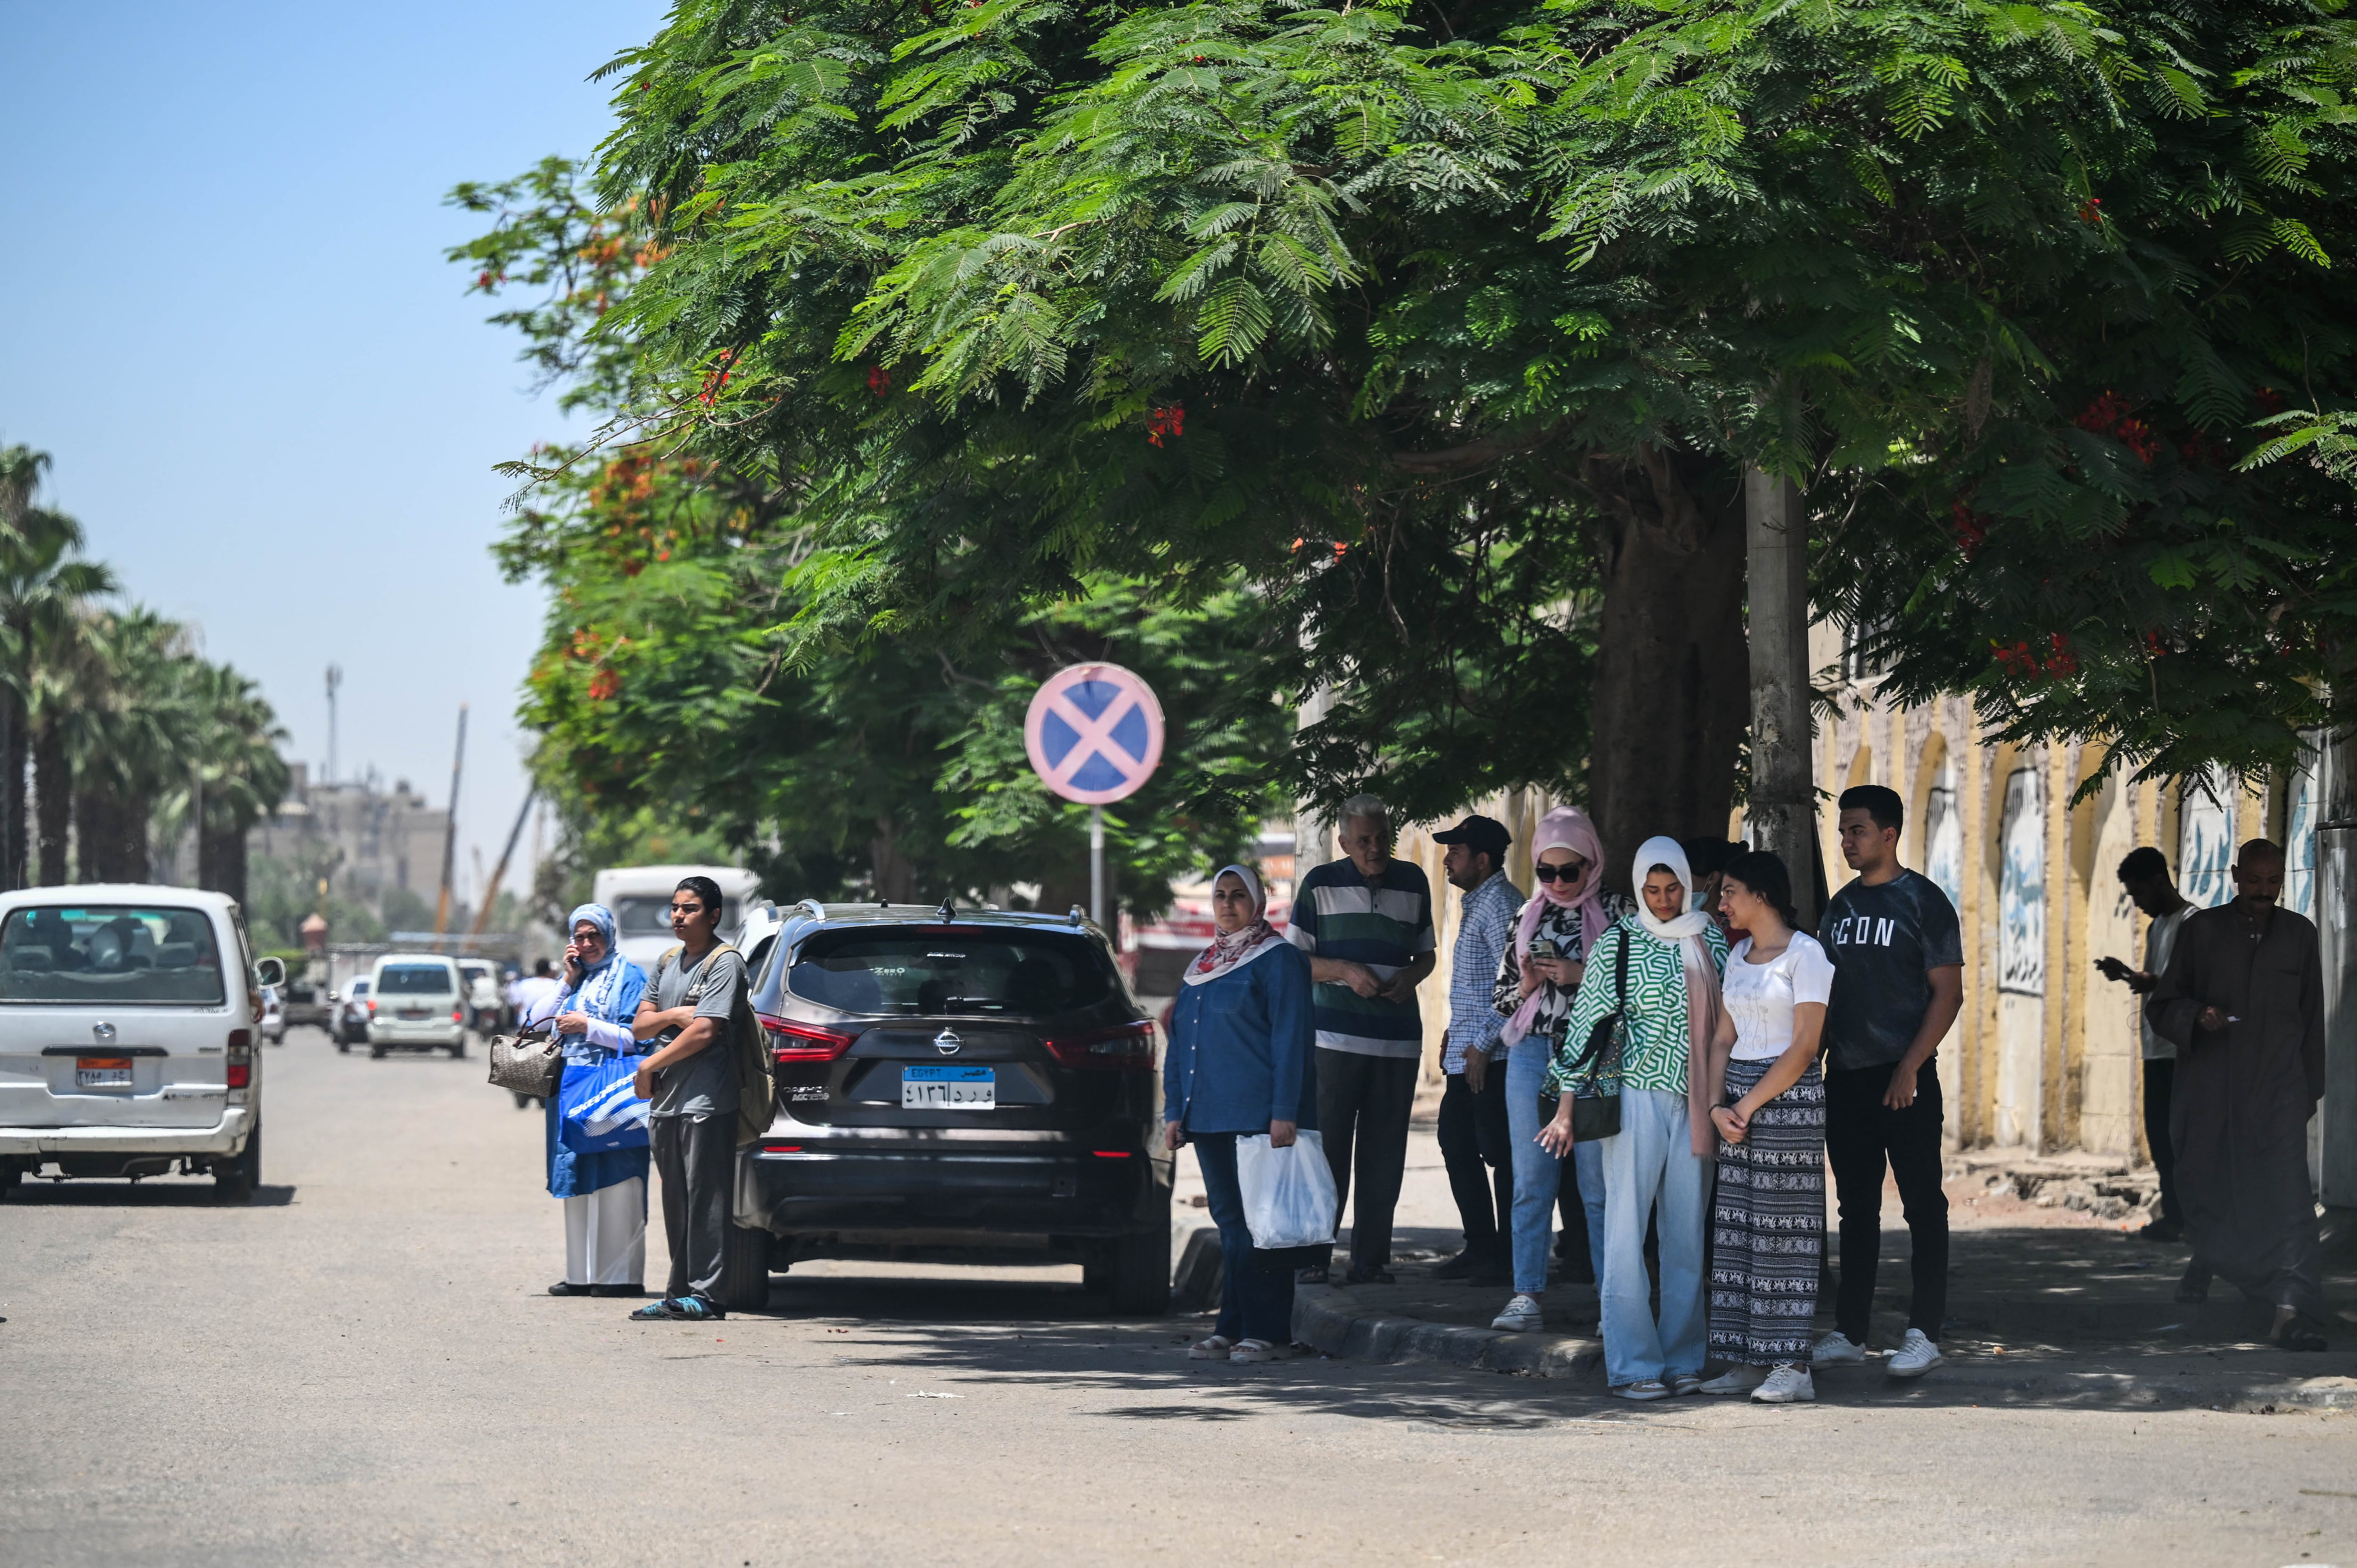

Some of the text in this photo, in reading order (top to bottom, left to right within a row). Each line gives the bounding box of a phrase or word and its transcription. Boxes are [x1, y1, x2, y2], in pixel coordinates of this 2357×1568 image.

[1831, 916, 1895, 947] ICON
[912, 1068, 941, 1077] EGYPT
[960, 1069, 986, 1078] مصر
[906, 1084, 946, 1102] ٤١٣٦
